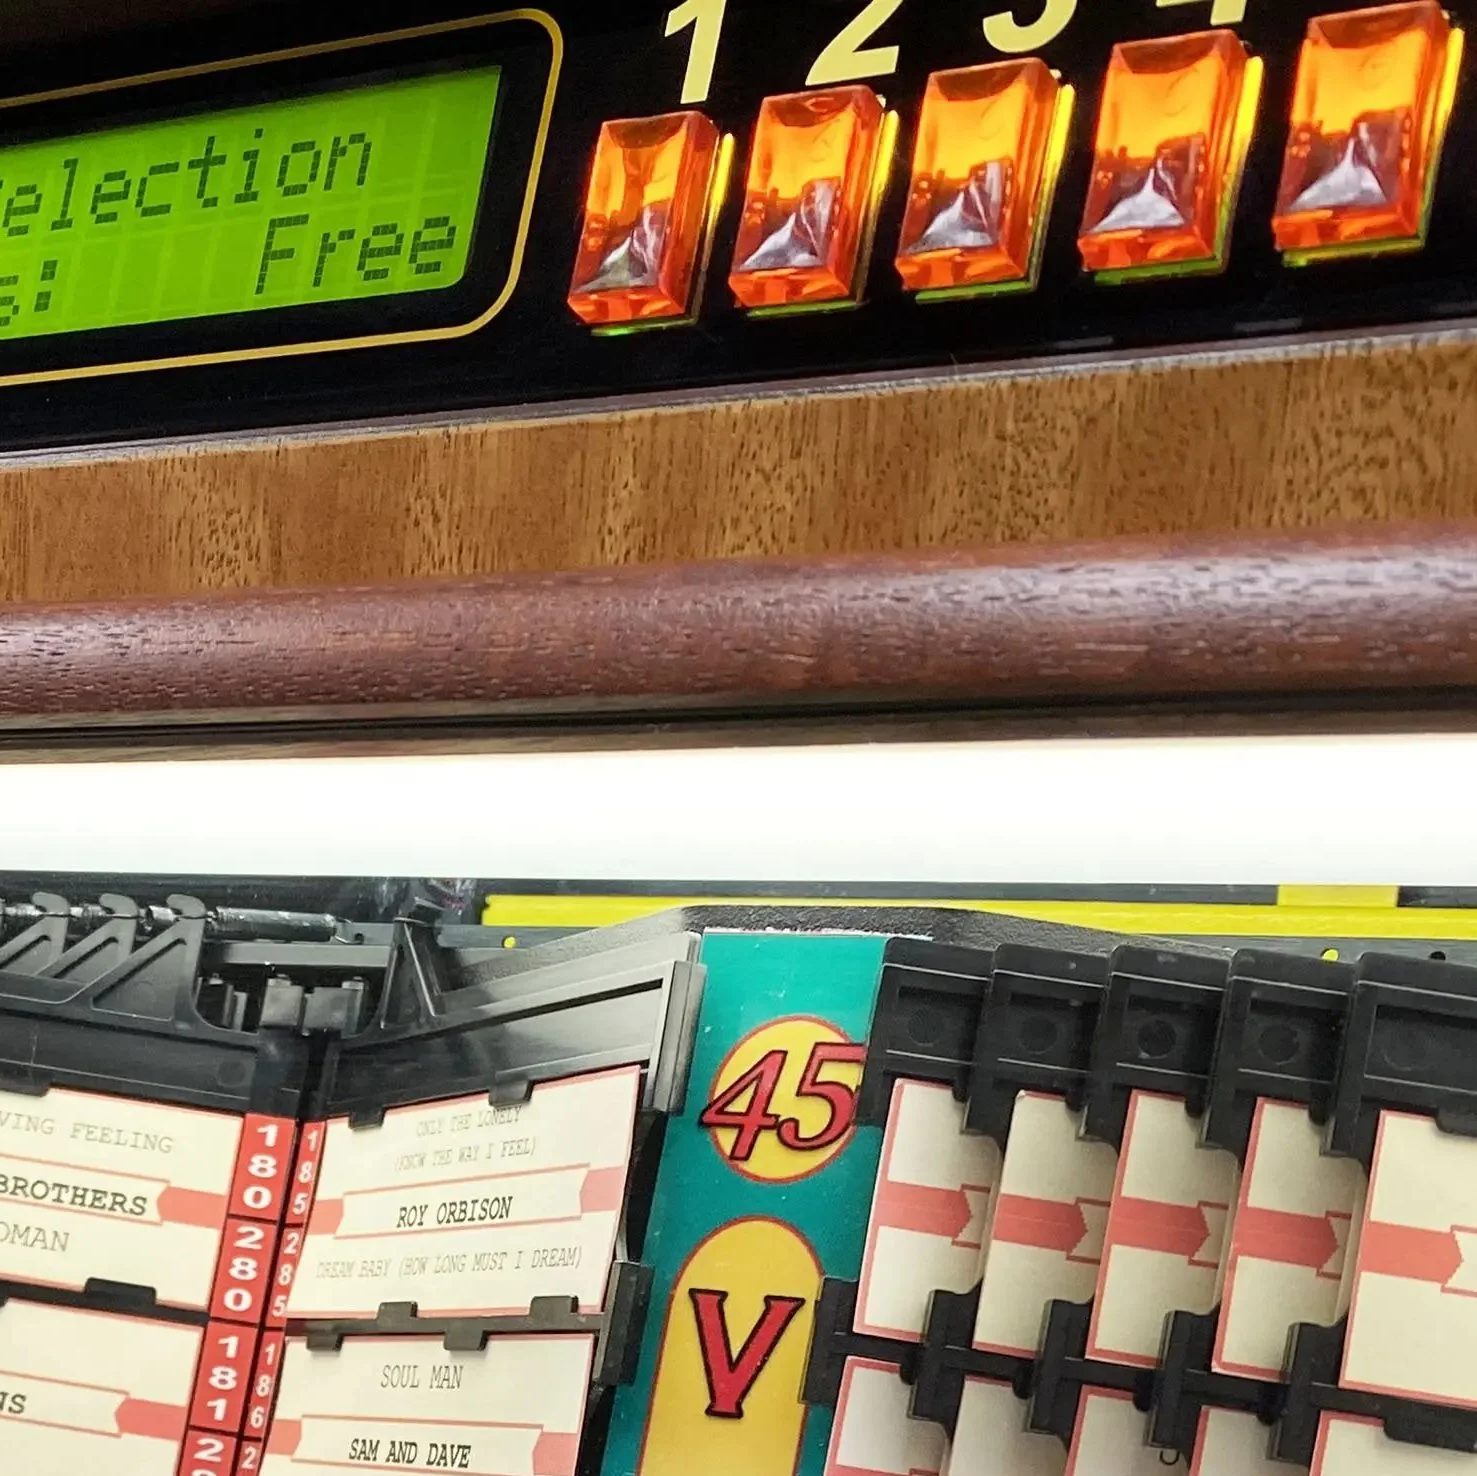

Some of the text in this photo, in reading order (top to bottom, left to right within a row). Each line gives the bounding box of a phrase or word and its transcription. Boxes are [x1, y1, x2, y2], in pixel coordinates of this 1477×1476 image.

[664, 0, 723, 104] 1
[805, 0, 900, 85] 2
[254, 212, 460, 295] Free
[699, 1042, 865, 1161] 45
[70, 1120, 173, 1154] FEELING
[486, 1144, 495, 1159] I
[396, 1195, 514, 1228] ROY ORBISON
[434, 1251, 466, 1273] LONG
[471, 1249, 508, 1270] MUST
[514, 1249, 523, 1267] I
[530, 1245, 582, 1270] DREAM)
[380, 1364, 464, 1389] SOUL MAN
[348, 1438, 472, 1469] SAM AND DAVE
